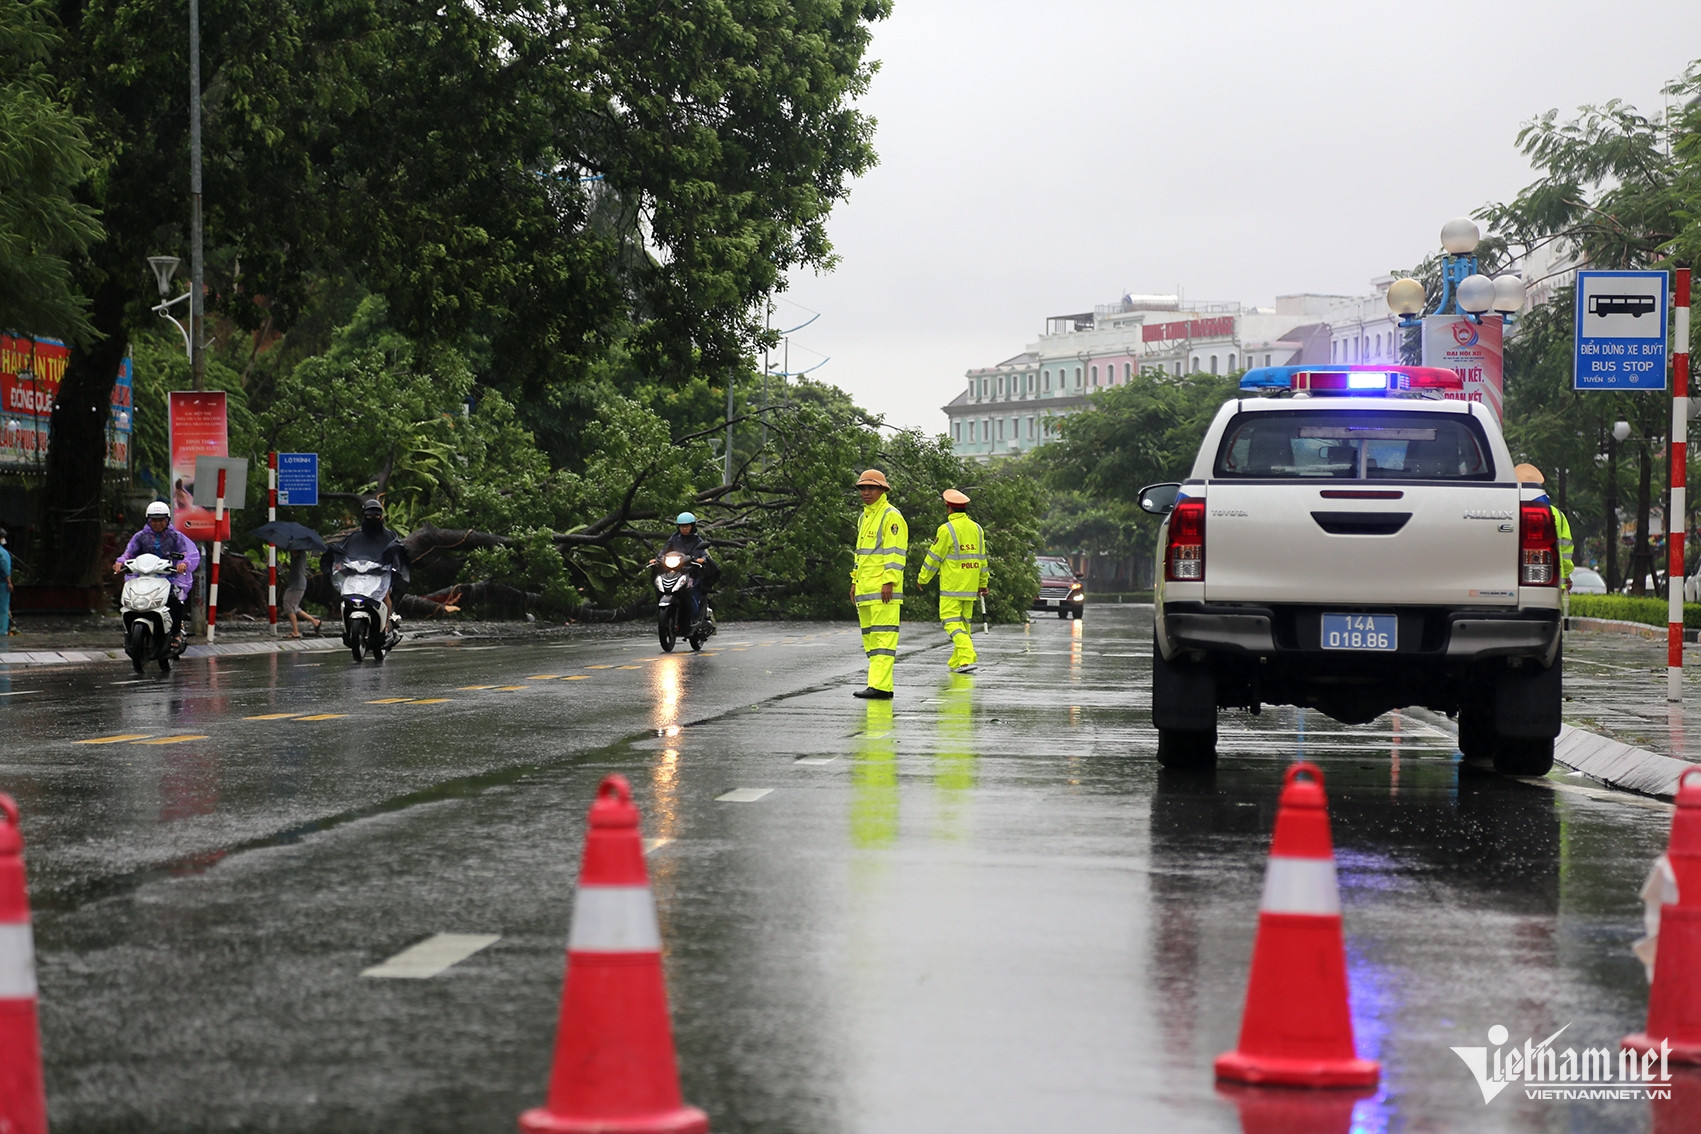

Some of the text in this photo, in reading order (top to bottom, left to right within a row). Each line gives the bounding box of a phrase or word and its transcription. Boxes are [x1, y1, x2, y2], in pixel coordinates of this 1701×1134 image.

[1580, 339, 1664, 355] ĐIỂM DỪNG XE BUÝT
[1592, 361, 1654, 372] BUS STOP
[1583, 374, 1604, 383] TUYẾN
[1463, 510, 1514, 520] HILUX
[1345, 615, 1375, 631] 14A
[1329, 631, 1389, 648] 018.86
